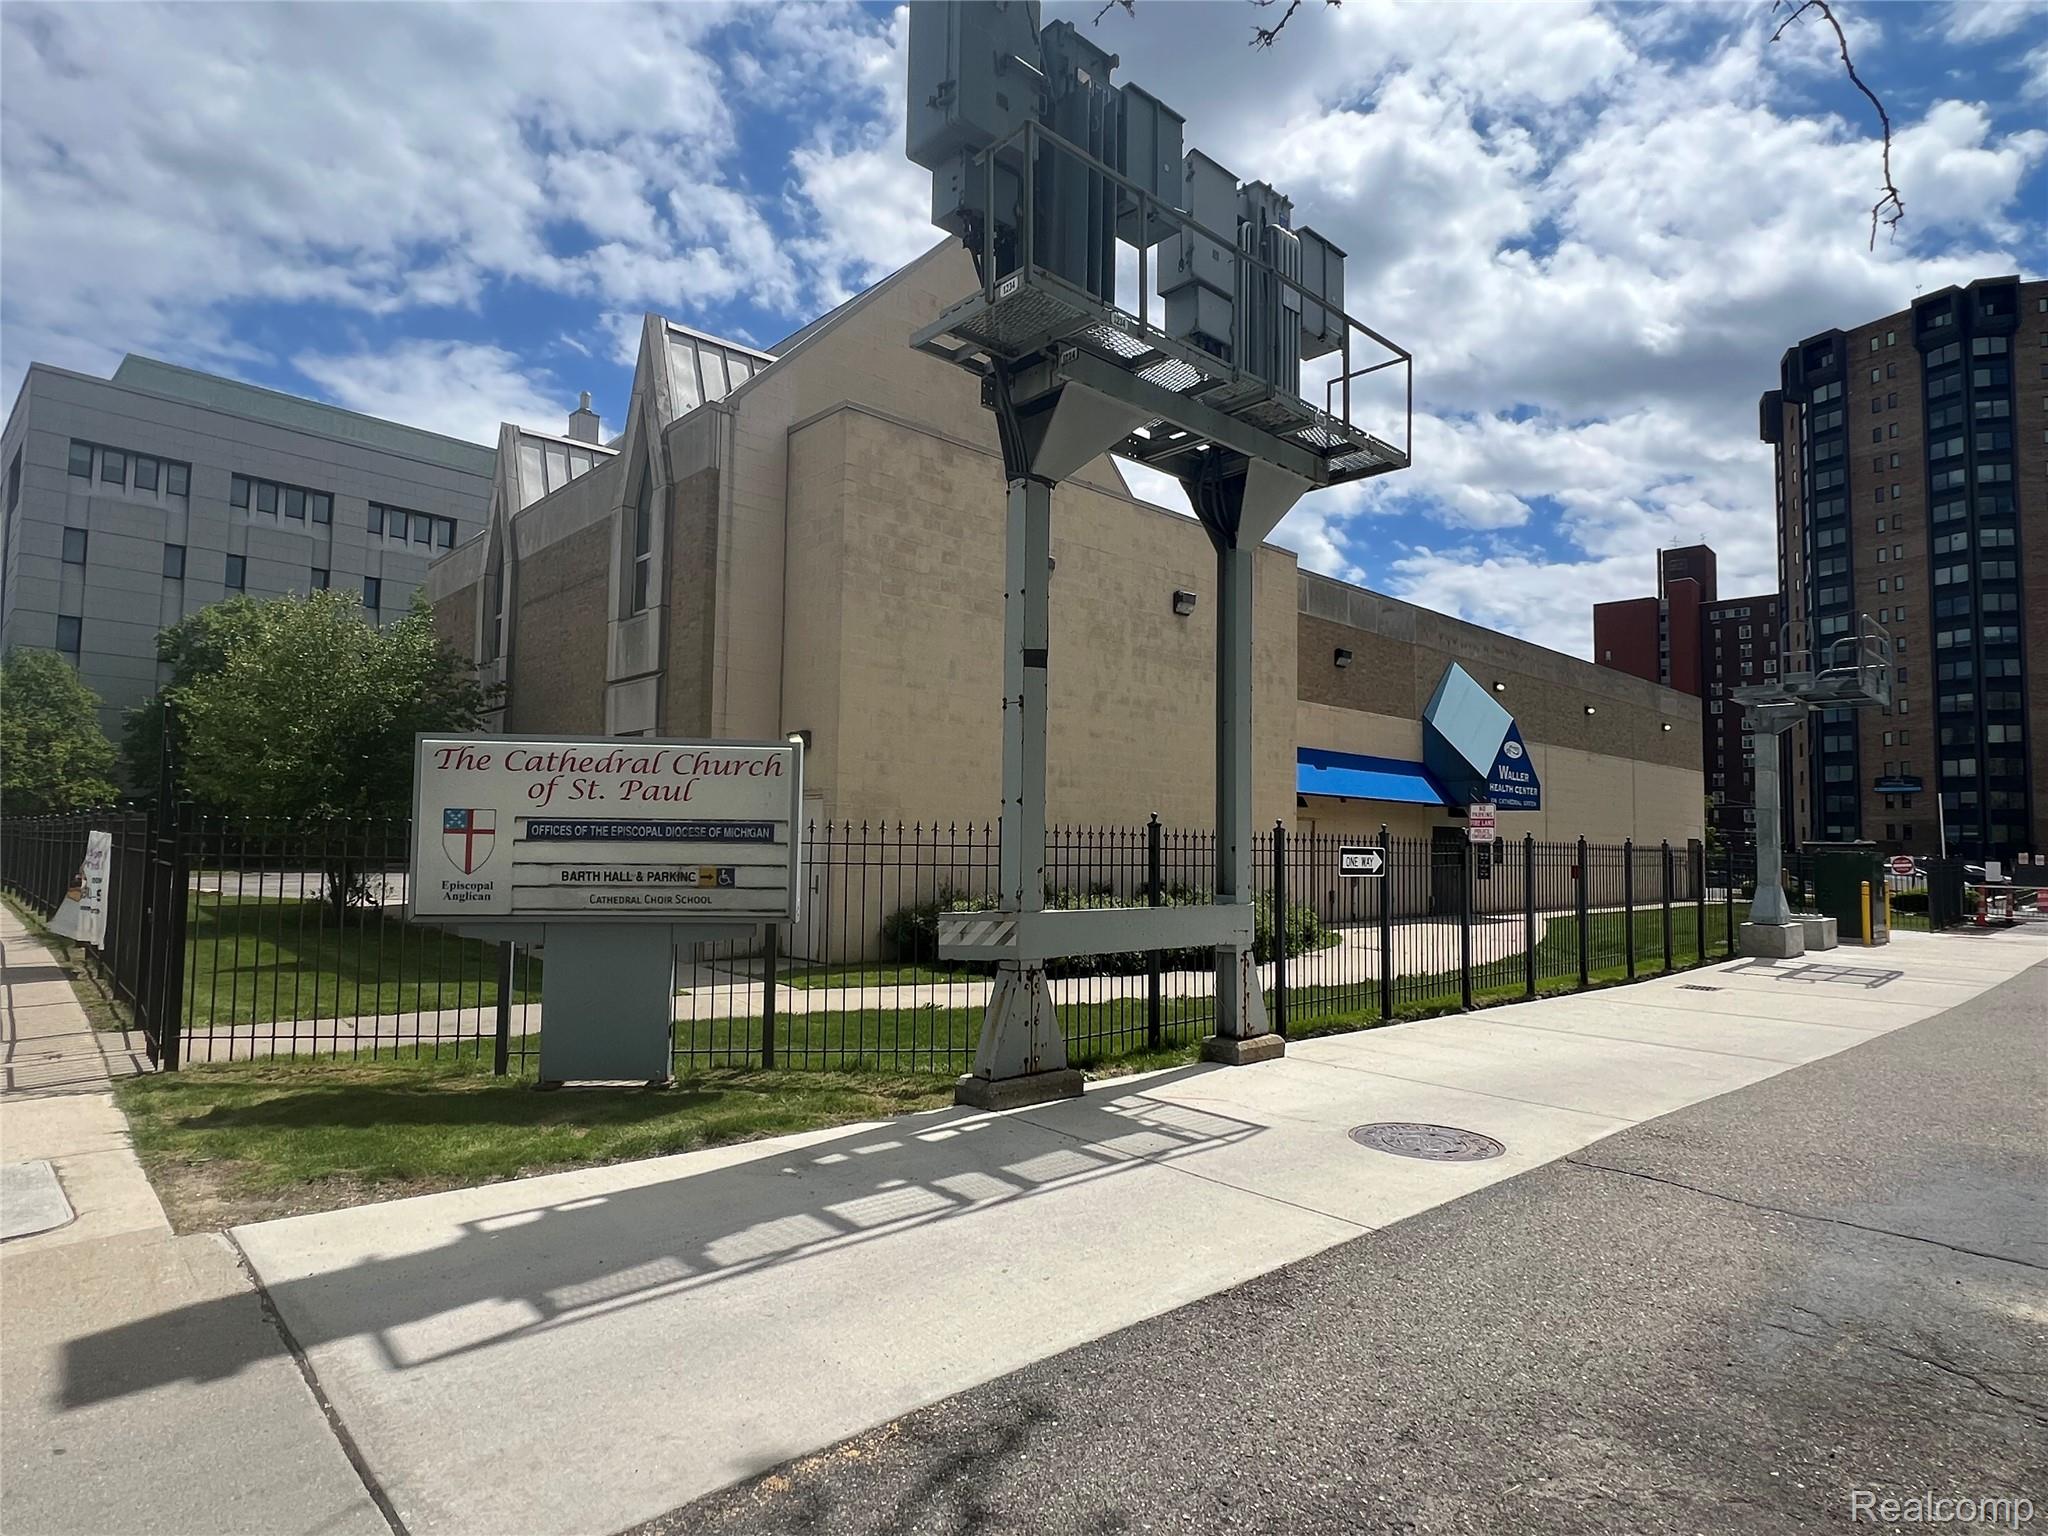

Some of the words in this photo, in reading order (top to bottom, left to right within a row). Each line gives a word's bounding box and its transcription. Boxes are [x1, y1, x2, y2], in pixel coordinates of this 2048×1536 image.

[1003, 279, 1016, 295] 1234
[434, 745, 492, 771] The
[504, 748, 670, 774] Cathedral
[672, 751, 783, 777] Church
[527, 774, 565, 808] of
[568, 778, 605, 800] St.
[619, 777, 700, 801] Paul
[1489, 783, 1514, 793] HEALTH
[1514, 785, 1538, 796] CENTER
[531, 824, 572, 836] OFFICES
[574, 825, 588, 836] OF
[590, 825, 609, 836] THE
[611, 825, 663, 837] EPISCOPAL
[665, 826, 706, 837] DIOCESE
[708, 826, 721, 838] OF
[723, 827, 770, 838] MICHIGAN
[1346, 856, 1359, 867] ONE
[1360, 856, 1375, 867] WAY
[561, 870, 600, 882] BARTH
[603, 871, 633, 882] HALL
[635, 871, 644, 882] &
[441, 880, 494, 893] Episcopal
[443, 891, 491, 903] Anglican
